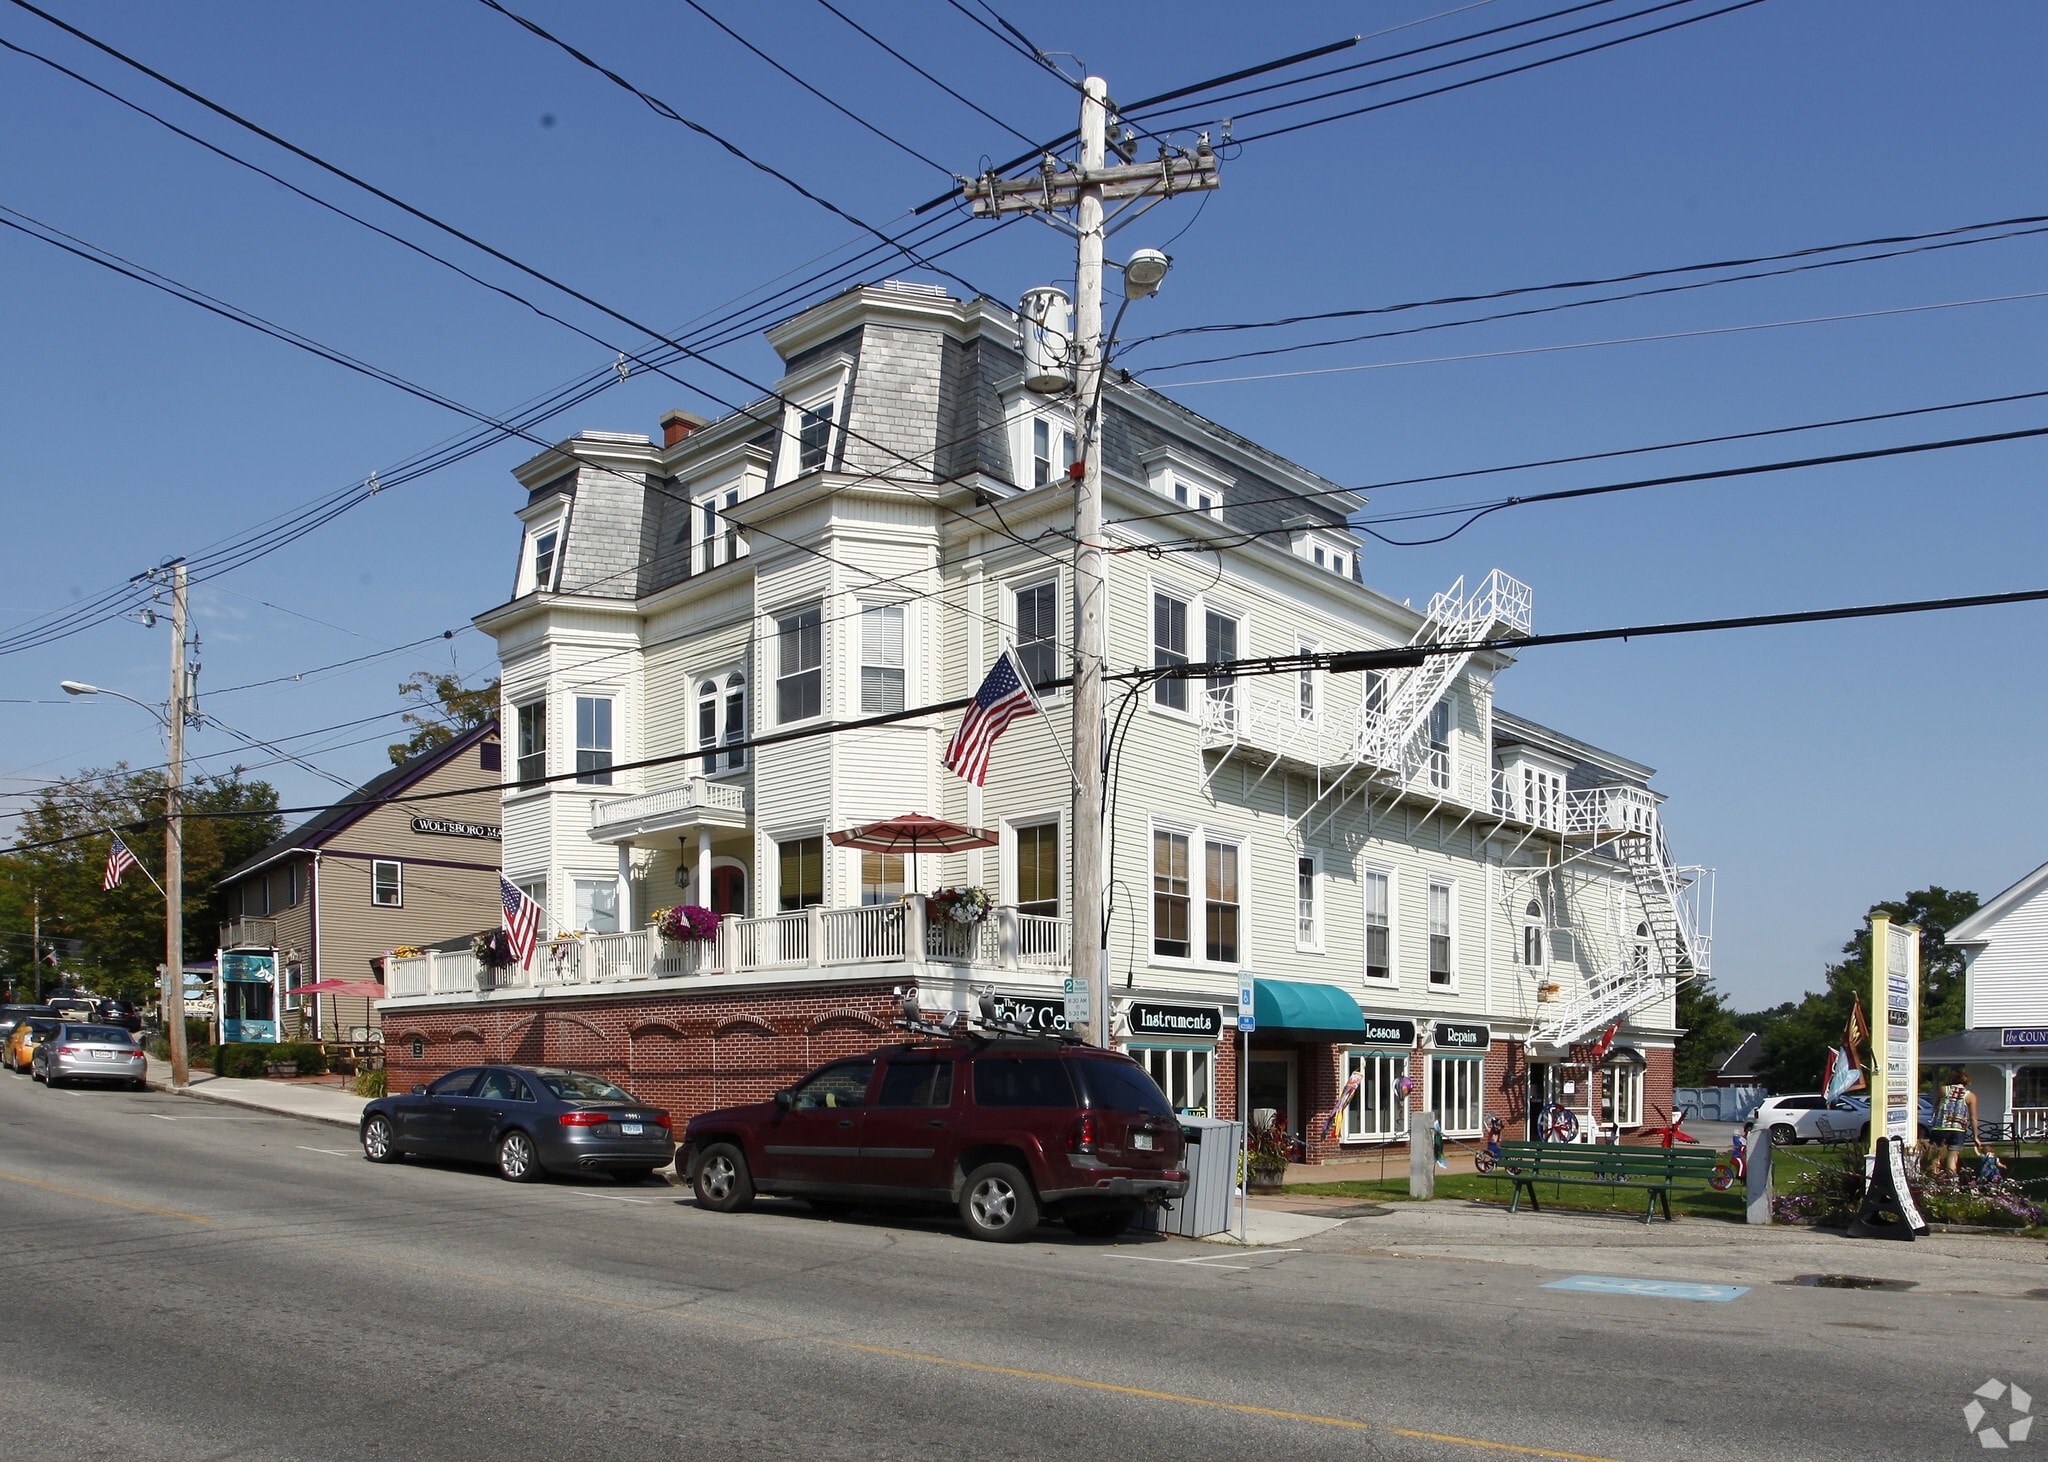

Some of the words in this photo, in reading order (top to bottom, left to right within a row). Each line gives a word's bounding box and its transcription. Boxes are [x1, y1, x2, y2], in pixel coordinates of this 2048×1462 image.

[1065, 980, 1073, 992] 2
[1004, 998, 1015, 1008] The
[1140, 1008, 1212, 1030] Instruments
[1365, 1023, 1401, 1040] Lessons
[1447, 1027, 1478, 1046] Repairs
[2005, 1030, 2018, 1044] the
